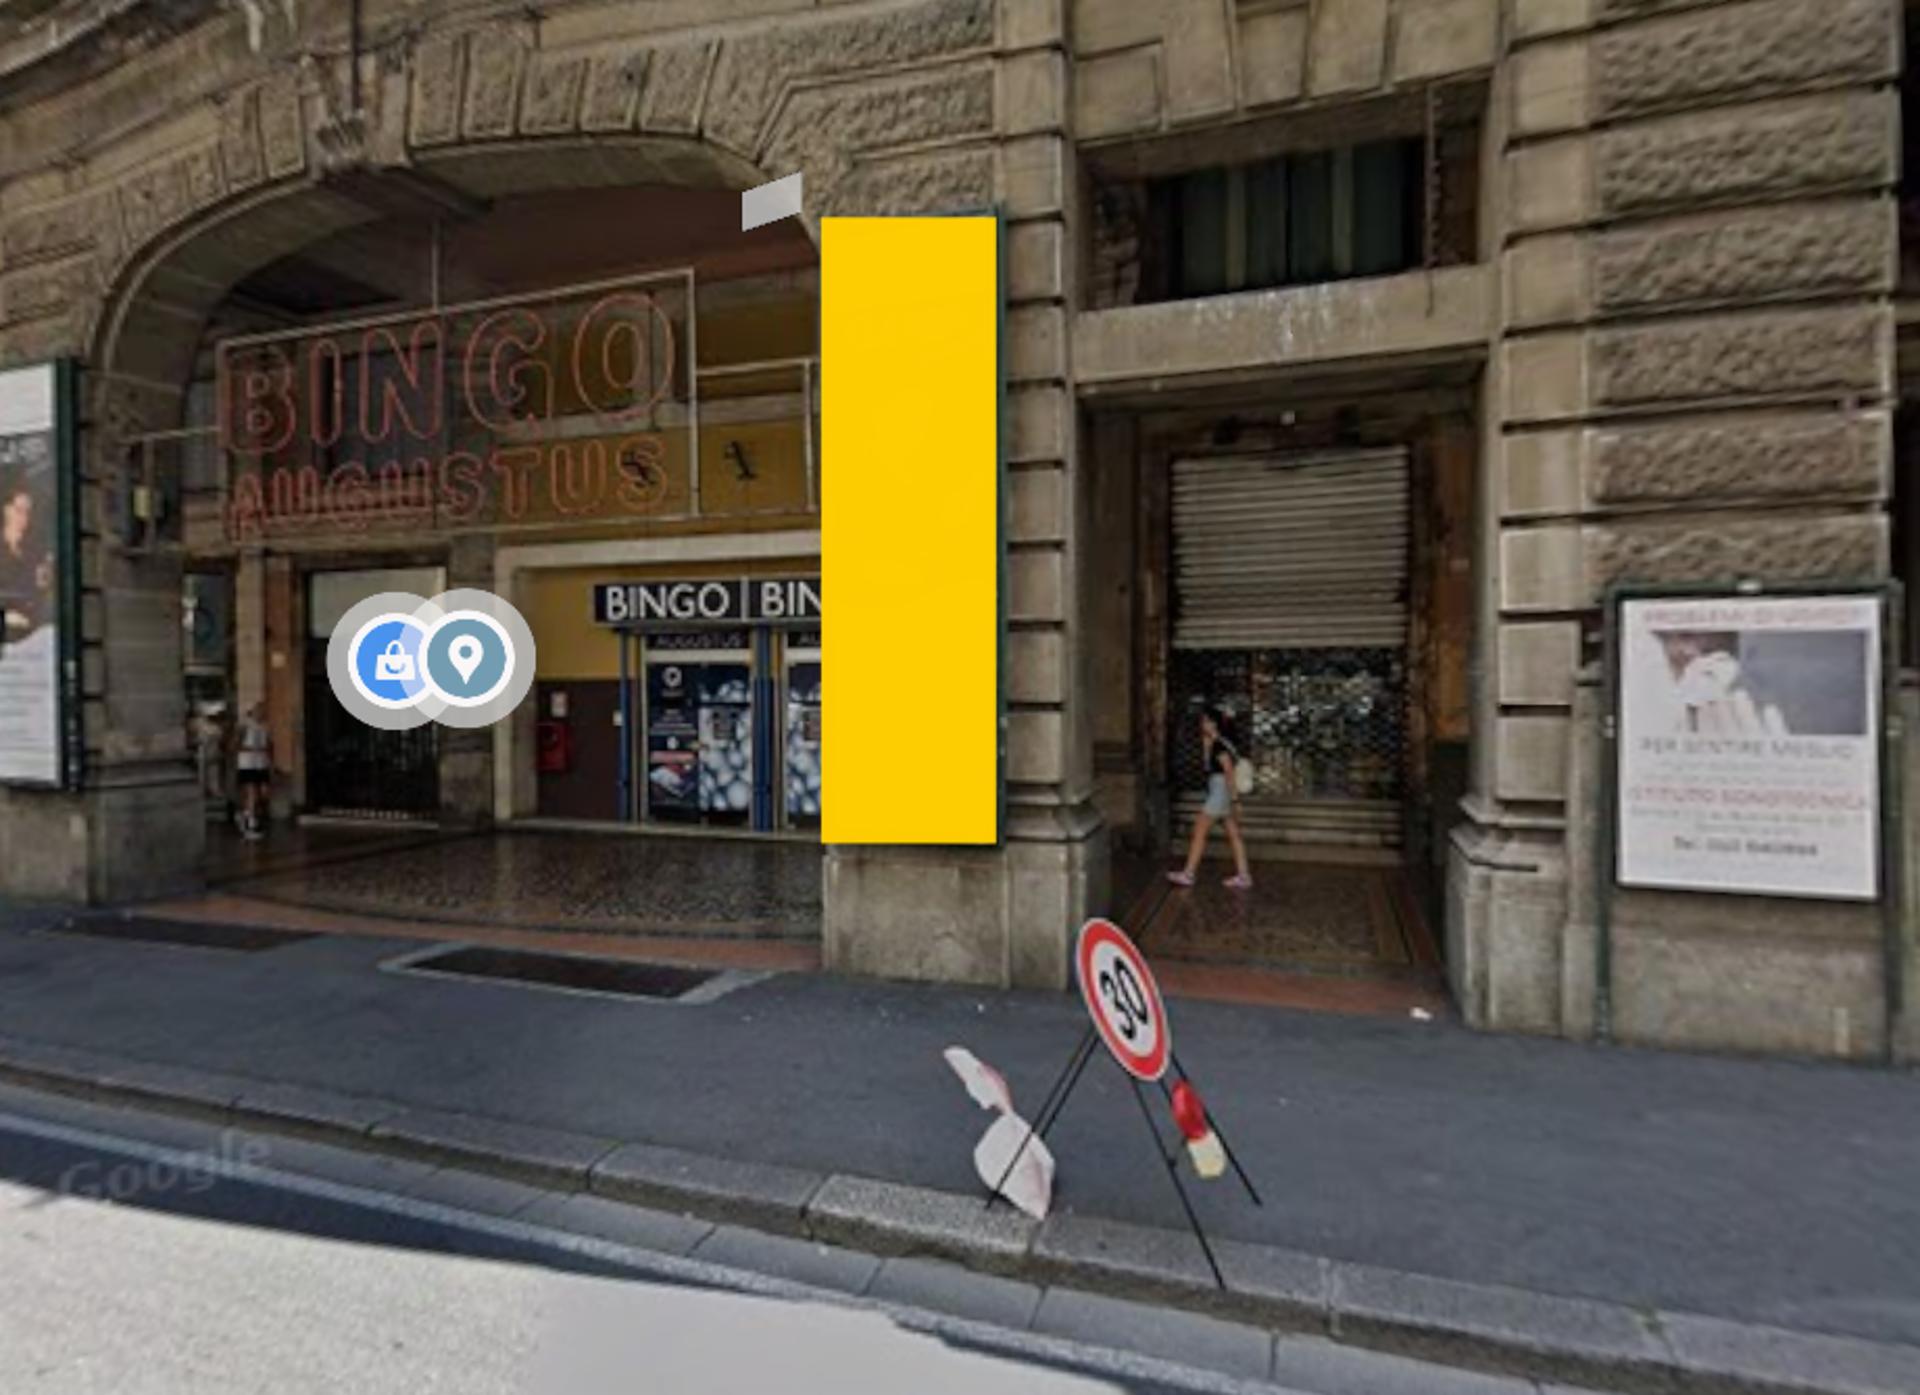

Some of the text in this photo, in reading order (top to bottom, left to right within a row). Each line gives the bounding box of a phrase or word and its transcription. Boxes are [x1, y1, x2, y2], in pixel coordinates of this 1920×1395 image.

[224, 291, 675, 453] BINGO
[228, 434, 669, 534] AUGUSTUS
[605, 583, 730, 621] BINGO
[1099, 956, 1148, 1040] 30
